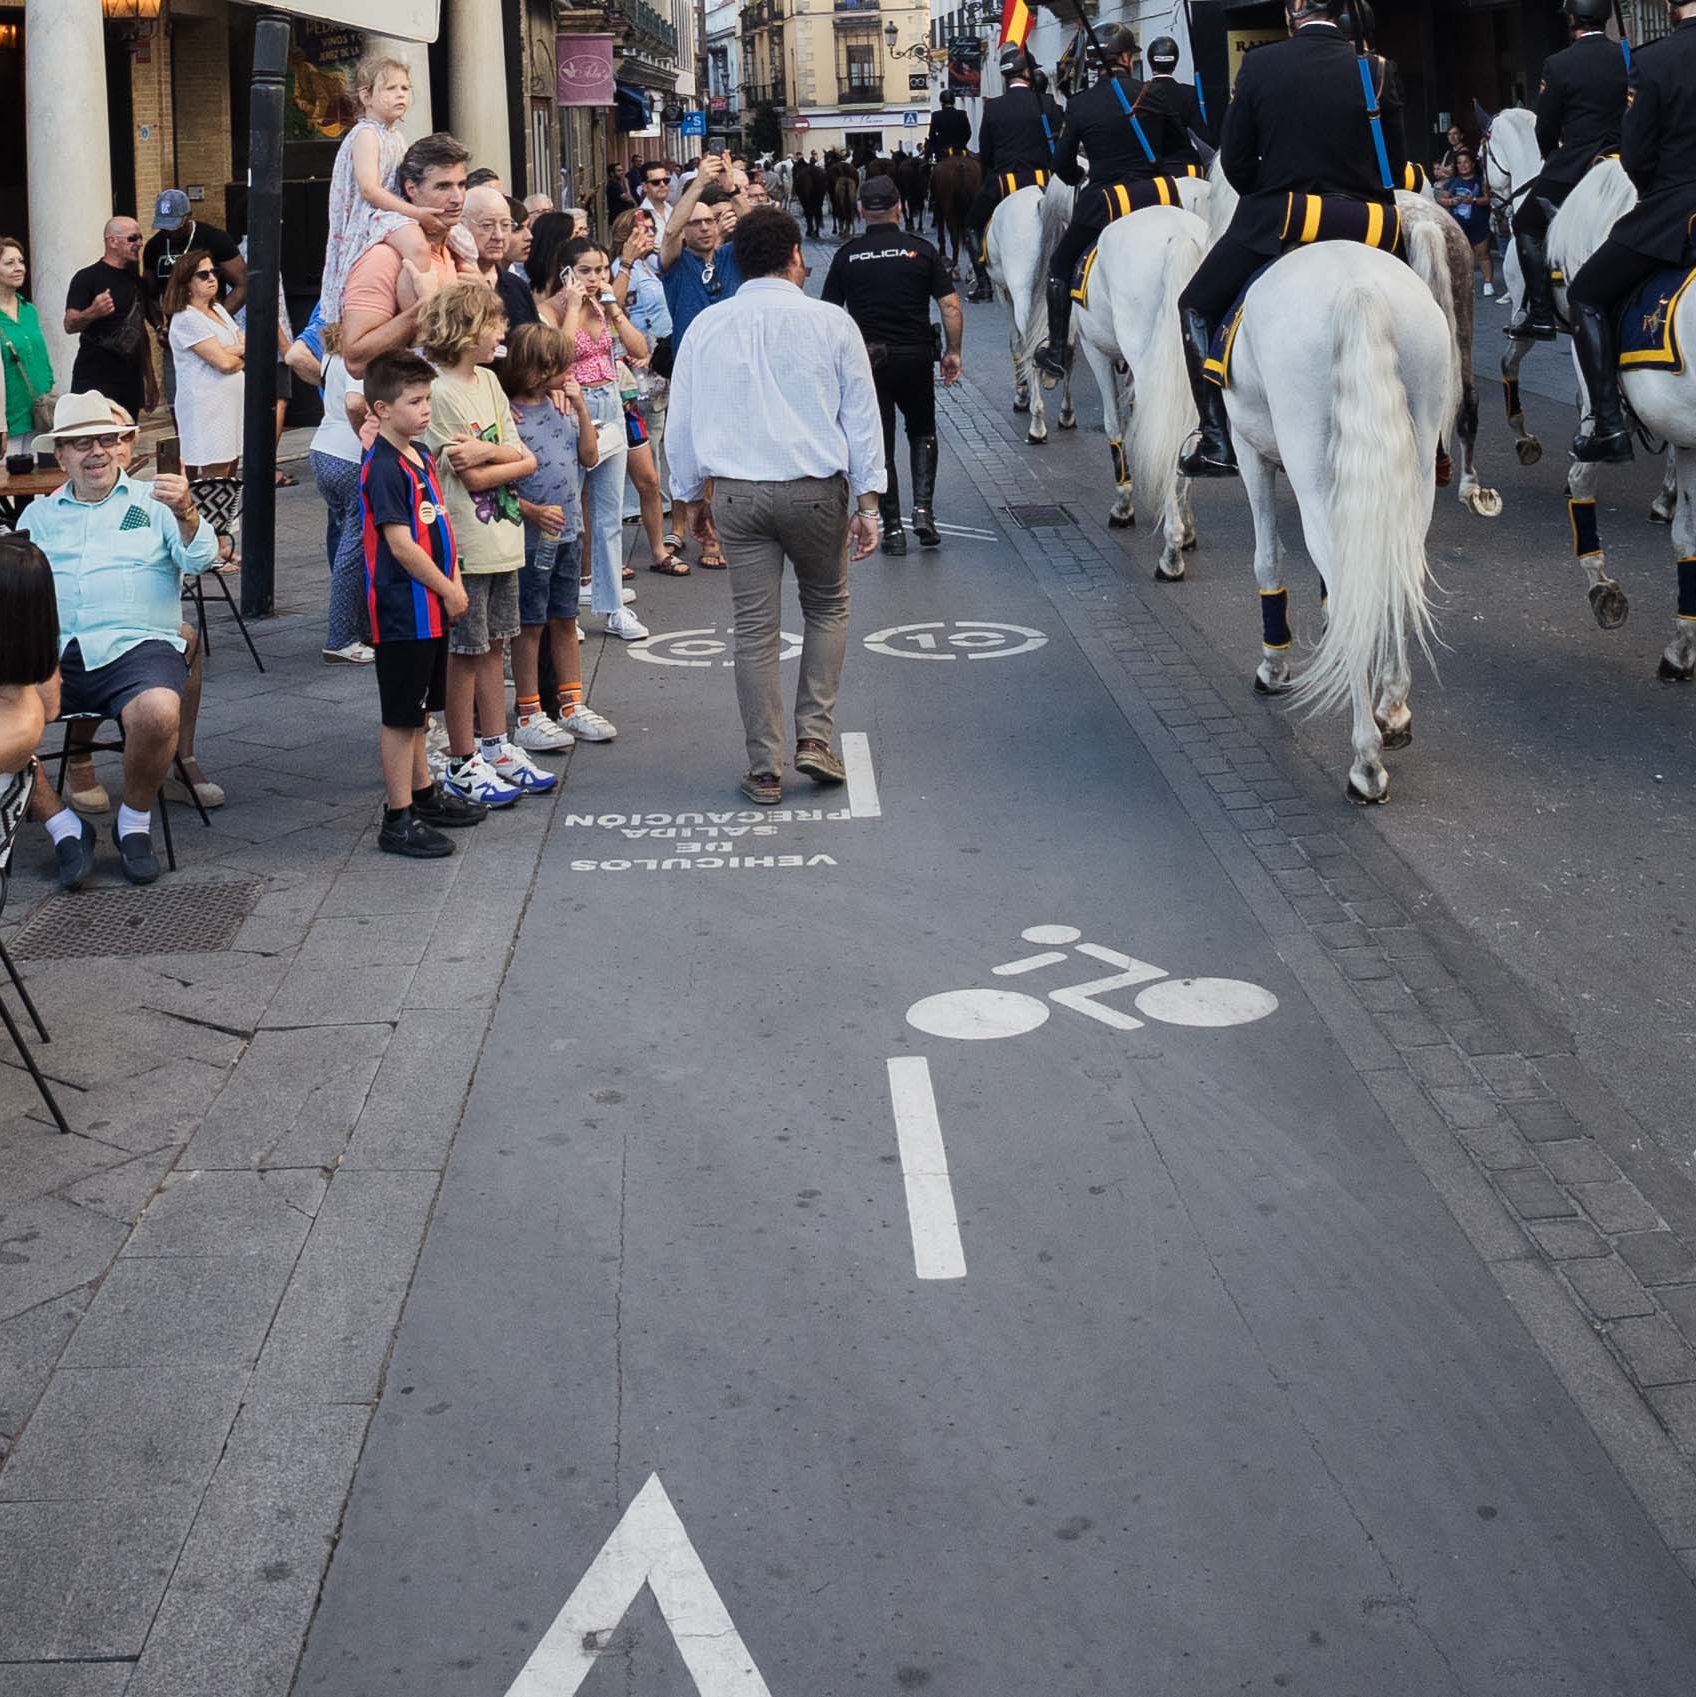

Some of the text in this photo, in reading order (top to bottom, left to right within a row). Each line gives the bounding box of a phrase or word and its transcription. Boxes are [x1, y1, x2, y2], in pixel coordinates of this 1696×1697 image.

[849, 248, 909, 263] POLICIA
[905, 631, 1006, 648] 10
[565, 808, 852, 830] PRECAUCIÓN
[620, 825, 779, 839] SALIDA
[675, 841, 733, 853] DE
[570, 854, 839, 871] VEHICULOS
